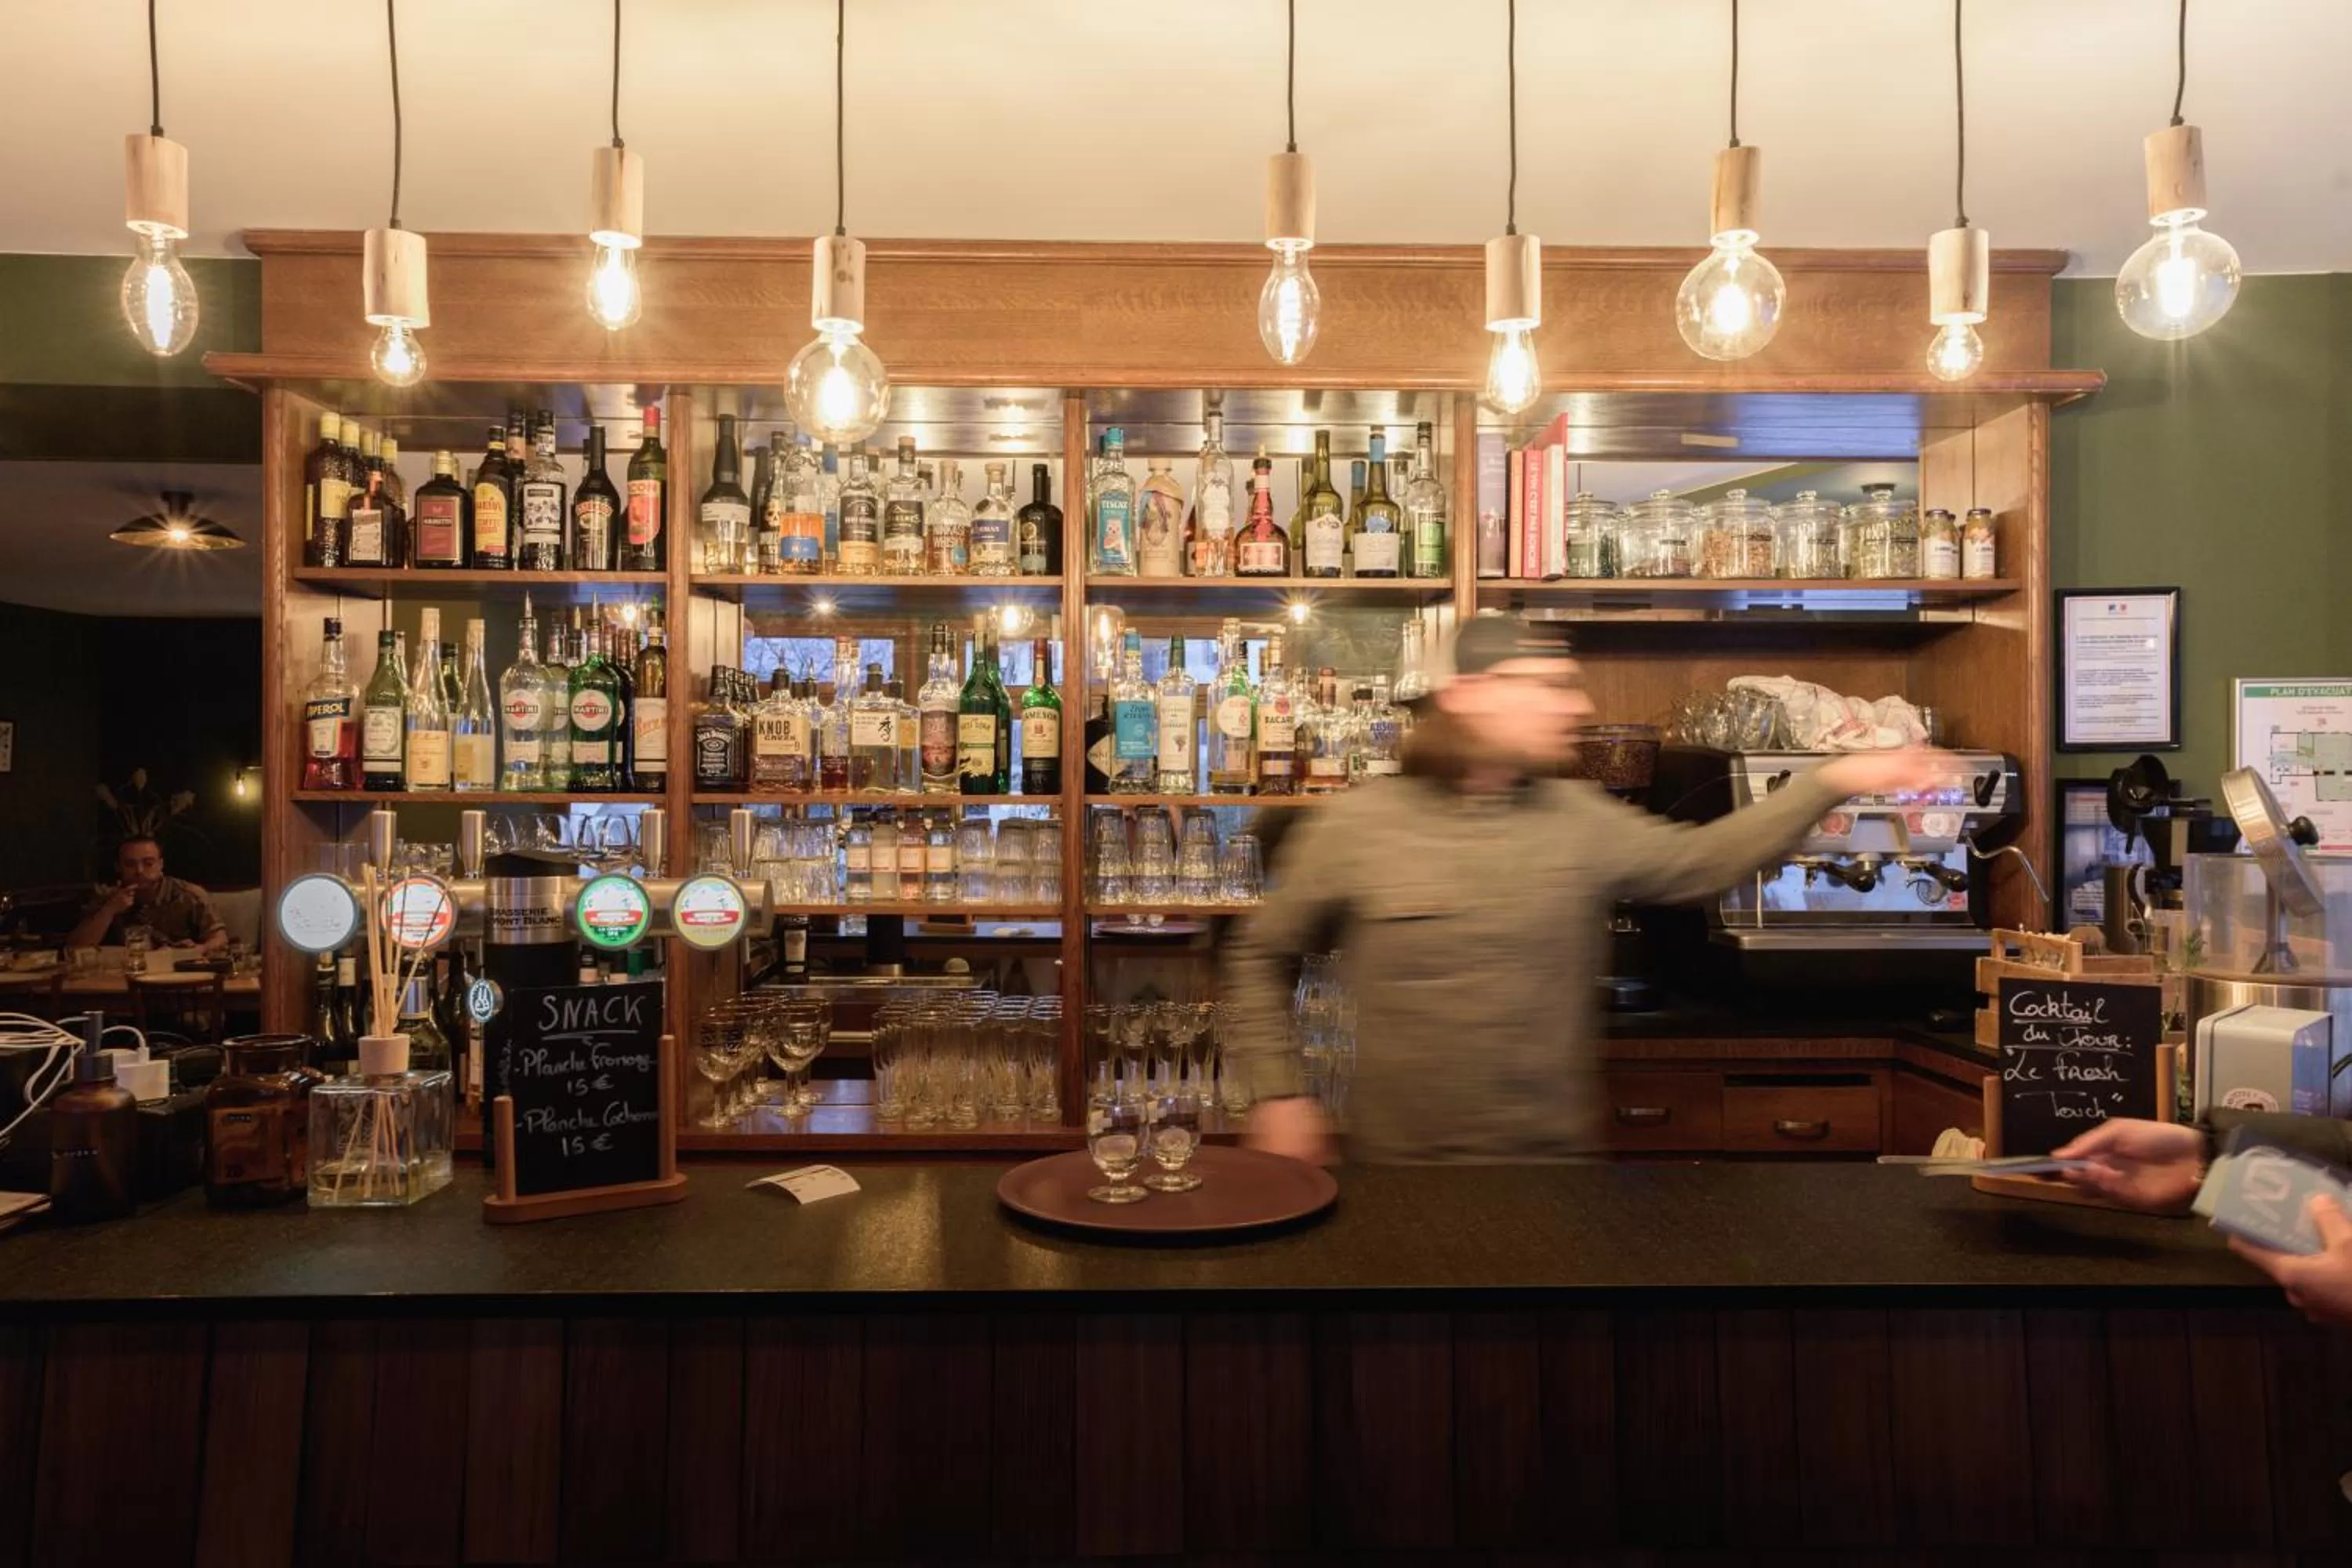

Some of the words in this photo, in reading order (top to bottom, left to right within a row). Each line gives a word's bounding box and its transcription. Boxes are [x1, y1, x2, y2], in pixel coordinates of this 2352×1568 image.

[504, 705, 539, 714] MARTINI
[573, 706, 609, 715] MARTINI
[757, 720, 791, 735] KNOB
[539, 994, 647, 1031] SNACK
[2009, 990, 2111, 1024] Cocktail
[2023, 1024, 2051, 1042] du
